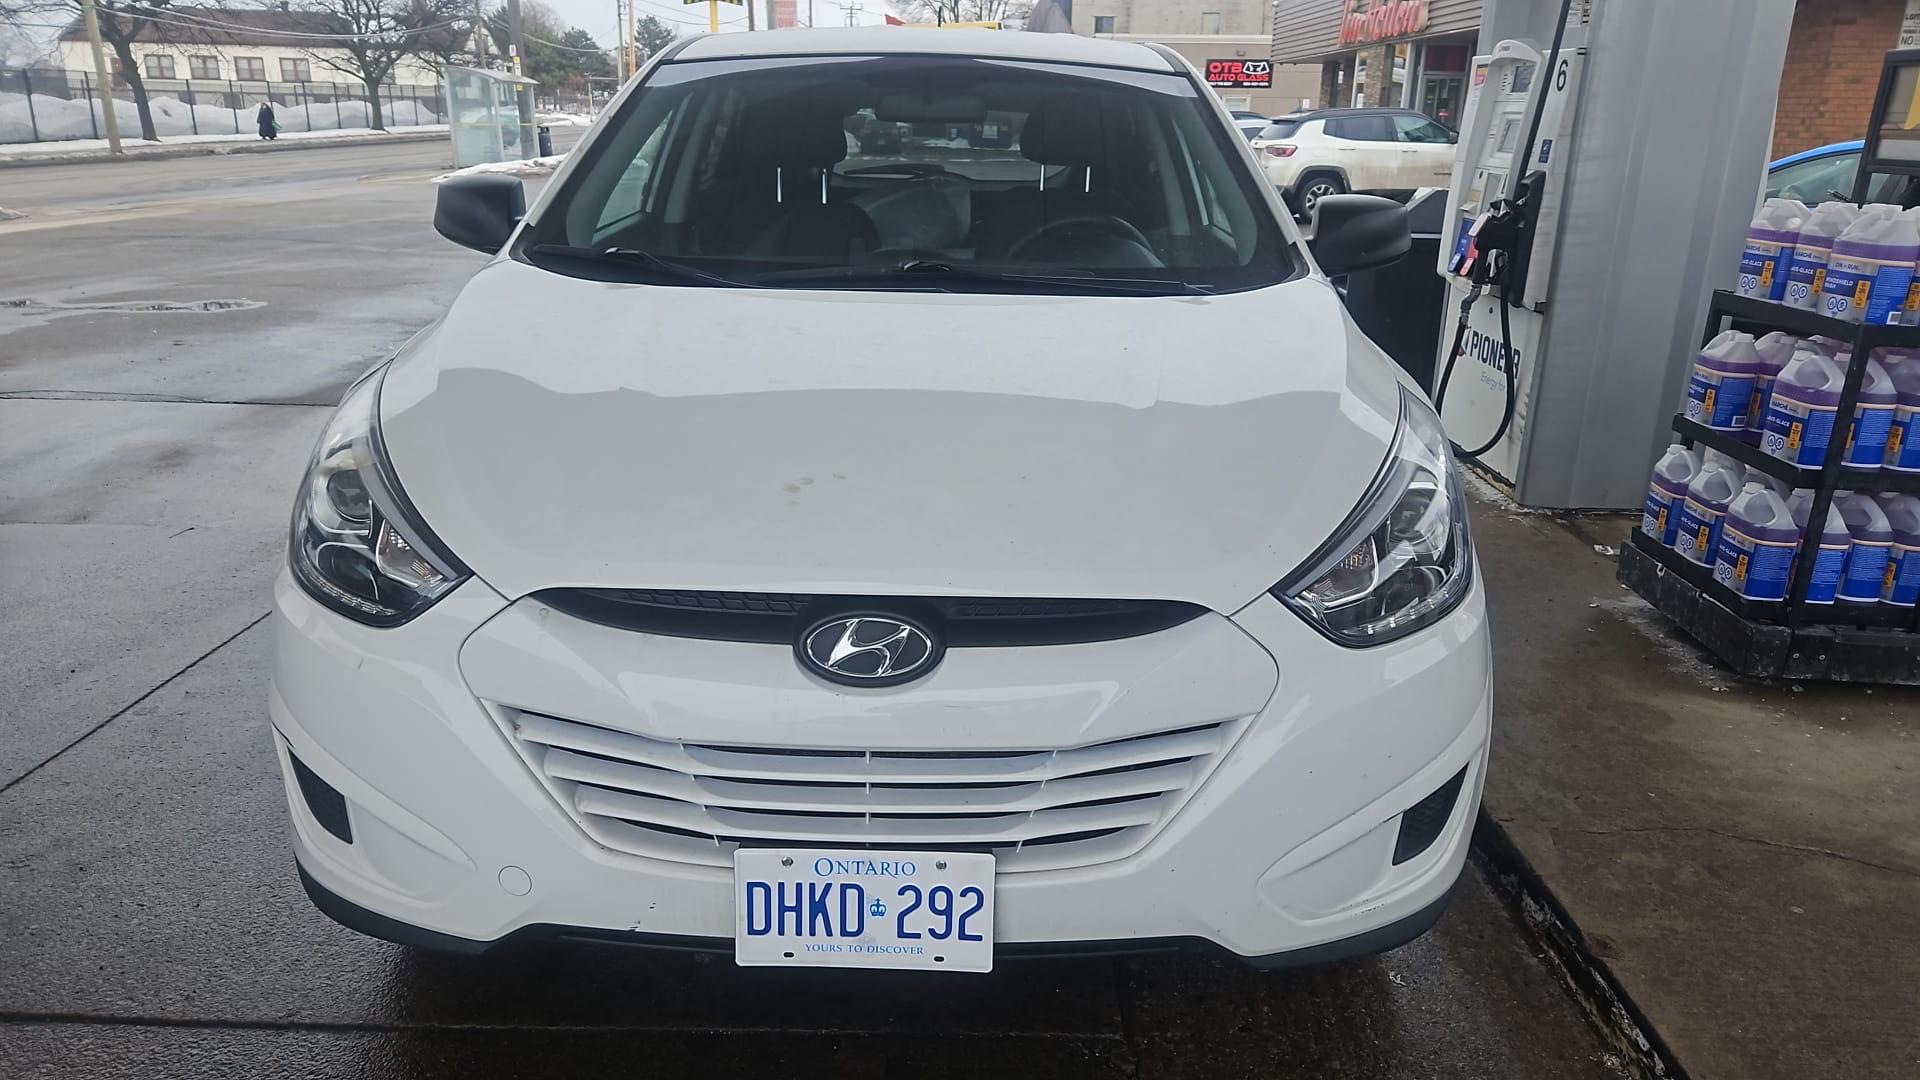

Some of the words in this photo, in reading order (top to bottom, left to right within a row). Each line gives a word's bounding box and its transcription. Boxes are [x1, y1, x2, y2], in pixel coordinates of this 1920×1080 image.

[1208, 73, 1235, 81] AUTO
[1237, 73, 1269, 81] GLASS
[1209, 62, 1243, 73] OTB
[1556, 58, 1569, 92] 6
[1470, 330, 1521, 379] PIONER
[814, 857, 916, 879] ONTARIO
[746, 881, 865, 937] DHKD
[896, 884, 985, 942] 292
[805, 943, 843, 952] YOURS
[848, 944, 863, 953] TO
[867, 945, 924, 955] DISCOVER
